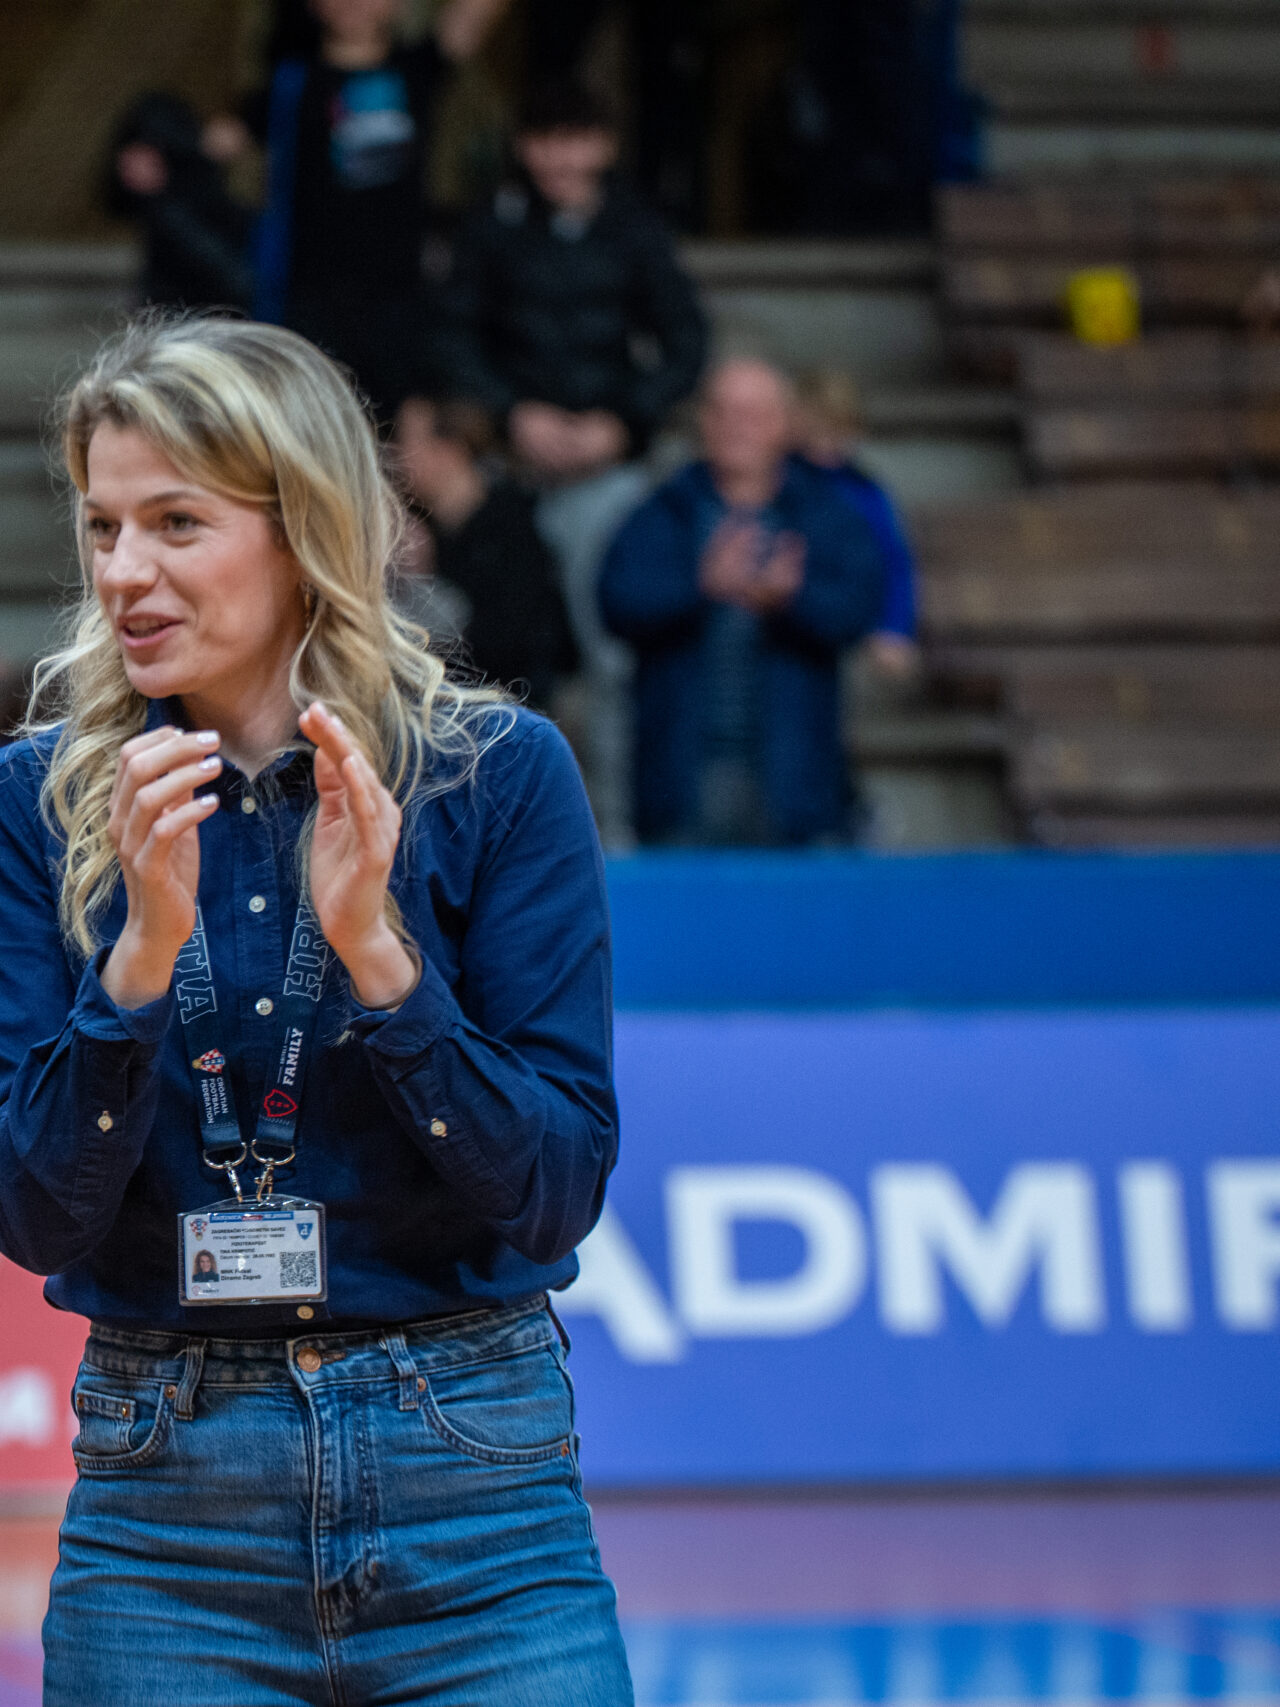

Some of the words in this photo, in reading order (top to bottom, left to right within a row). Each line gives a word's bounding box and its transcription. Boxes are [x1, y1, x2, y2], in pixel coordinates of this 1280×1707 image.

[282, 1027, 304, 1086] FAMILY
[201, 1080, 214, 1124] FEDERATION
[209, 1079, 220, 1115] FOOTBALL
[217, 1077, 228, 1113] CROATIAN
